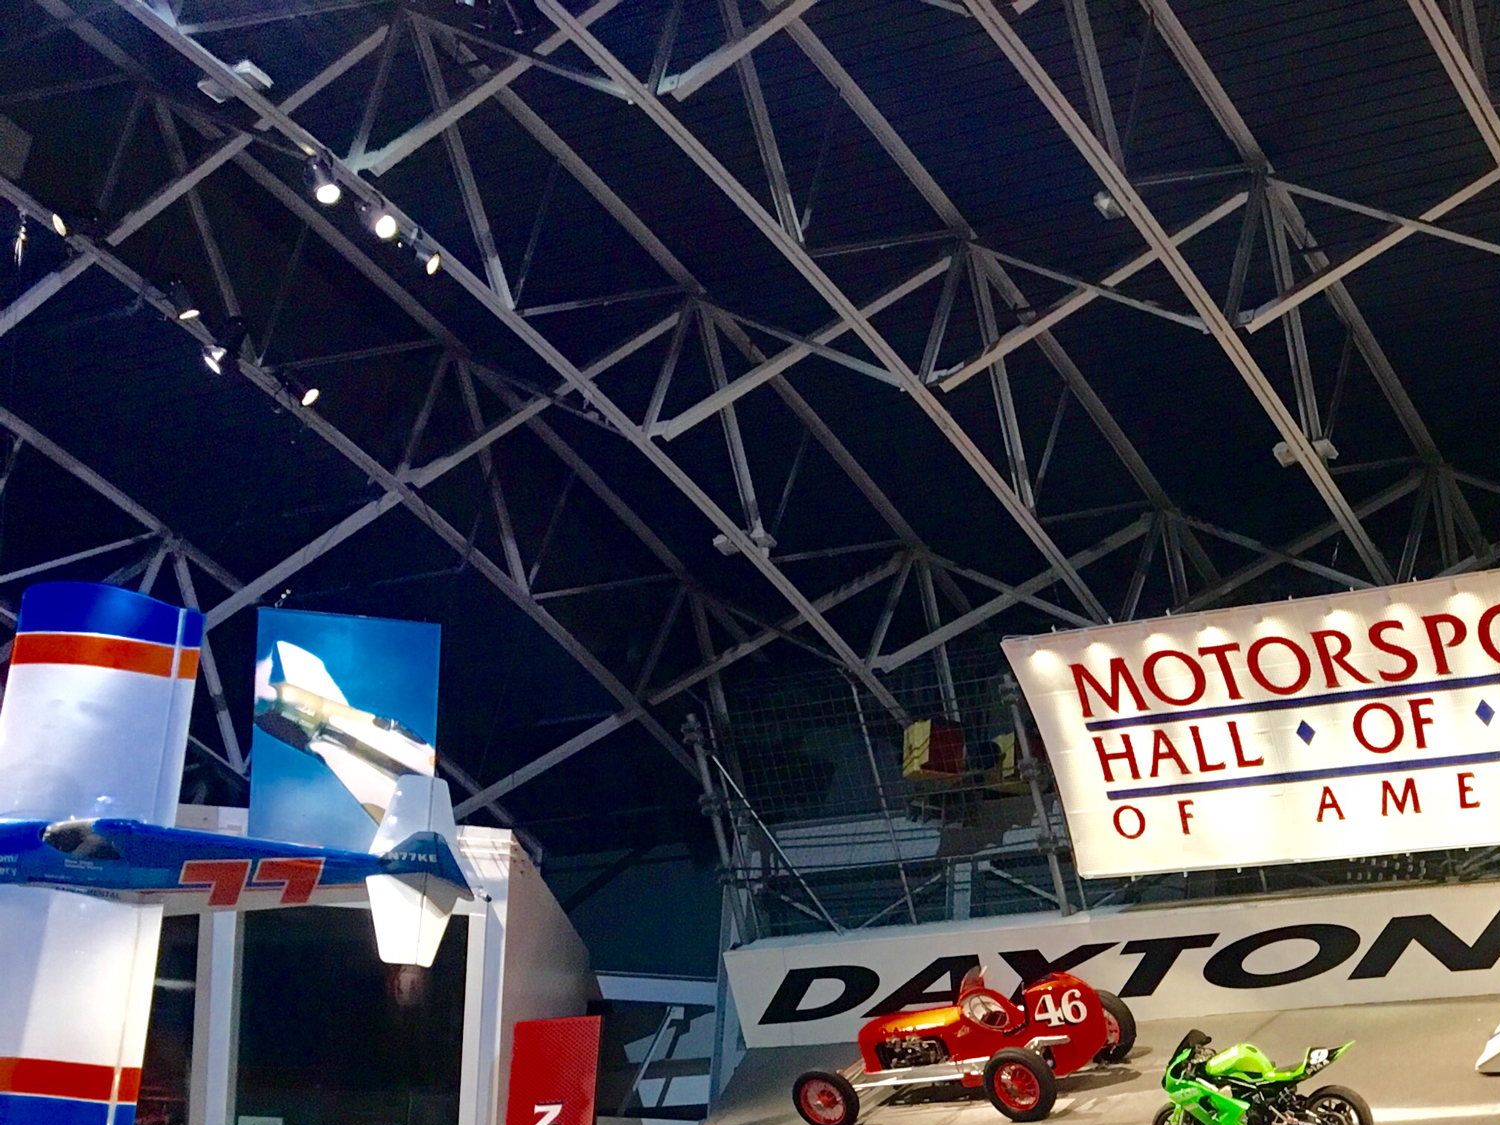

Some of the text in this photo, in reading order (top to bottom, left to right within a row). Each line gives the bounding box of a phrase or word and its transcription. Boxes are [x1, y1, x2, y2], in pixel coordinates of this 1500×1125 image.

[1093, 721, 1264, 783] HALL
[1353, 698, 1435, 755] OF
[1113, 800, 1196, 840] OF
[178, 857, 326, 906] 77
[1034, 988, 1088, 1028] 46
